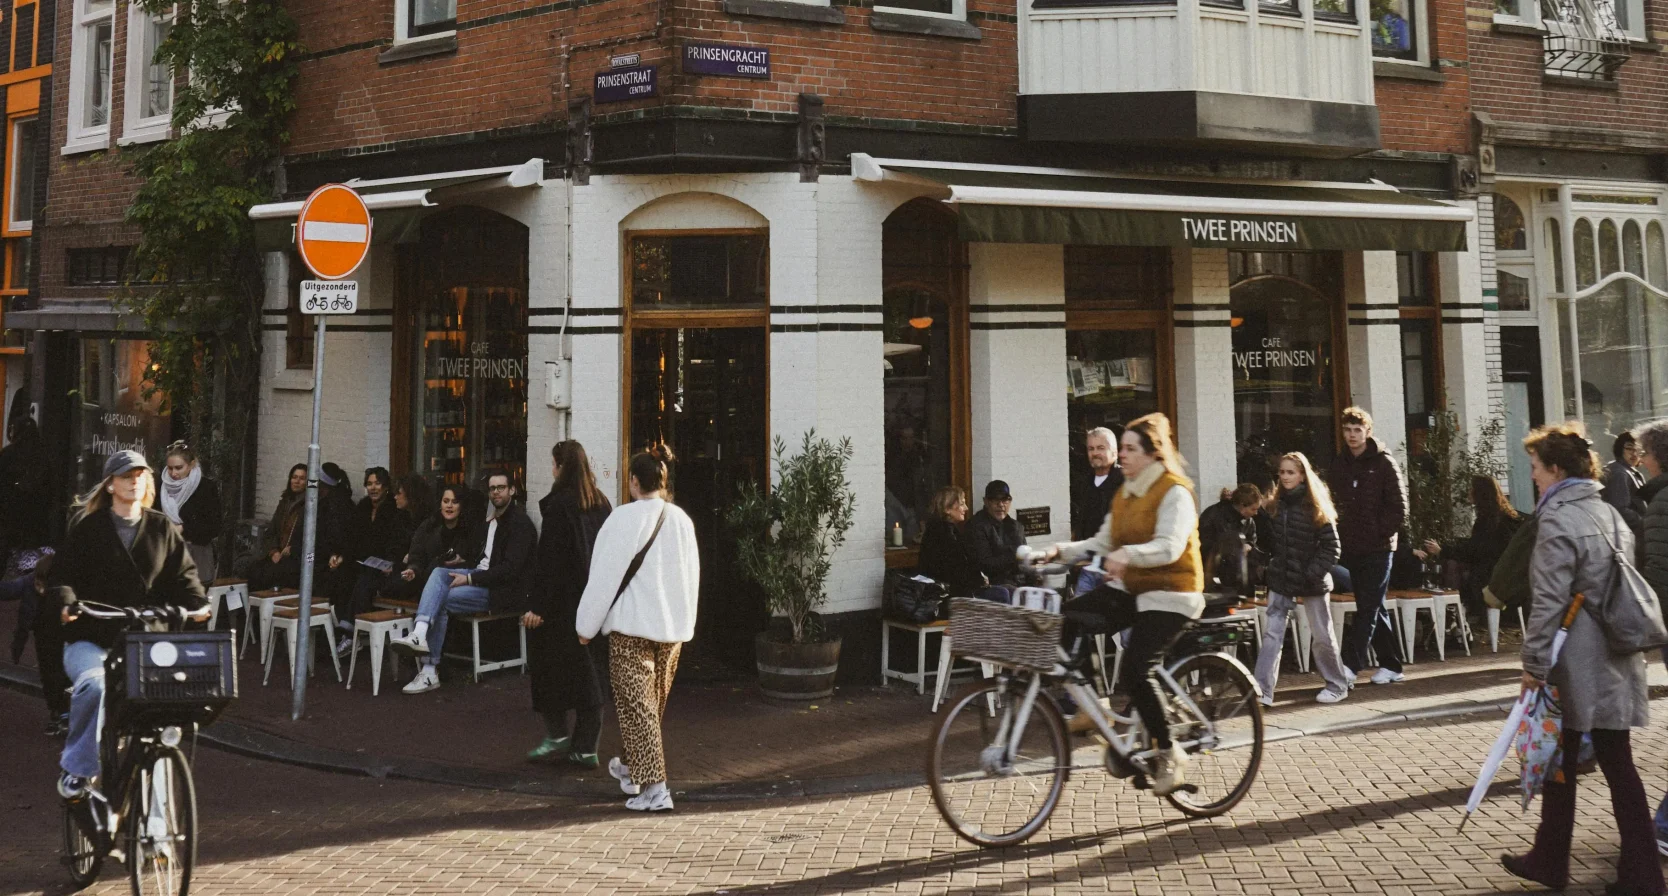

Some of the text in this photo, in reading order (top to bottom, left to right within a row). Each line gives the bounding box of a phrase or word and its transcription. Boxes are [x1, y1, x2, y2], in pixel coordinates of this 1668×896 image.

[687, 46, 767, 65] PRINSENGRACHT
[737, 65, 767, 74] CENTRUM
[597, 70, 652, 89] PRINSENSTRAAT
[629, 85, 652, 95] CENTRUM
[1181, 217, 1297, 243] TWEE PRINSEN
[304, 282, 356, 292] Uitgezonderd
[470, 341, 489, 354] CAFE
[1261, 337, 1281, 348] CAFE
[1232, 350, 1316, 368] WEE PRINSEN
[439, 357, 524, 379] TWEE PRINSEN
[104, 413, 137, 427] KAPSALON
